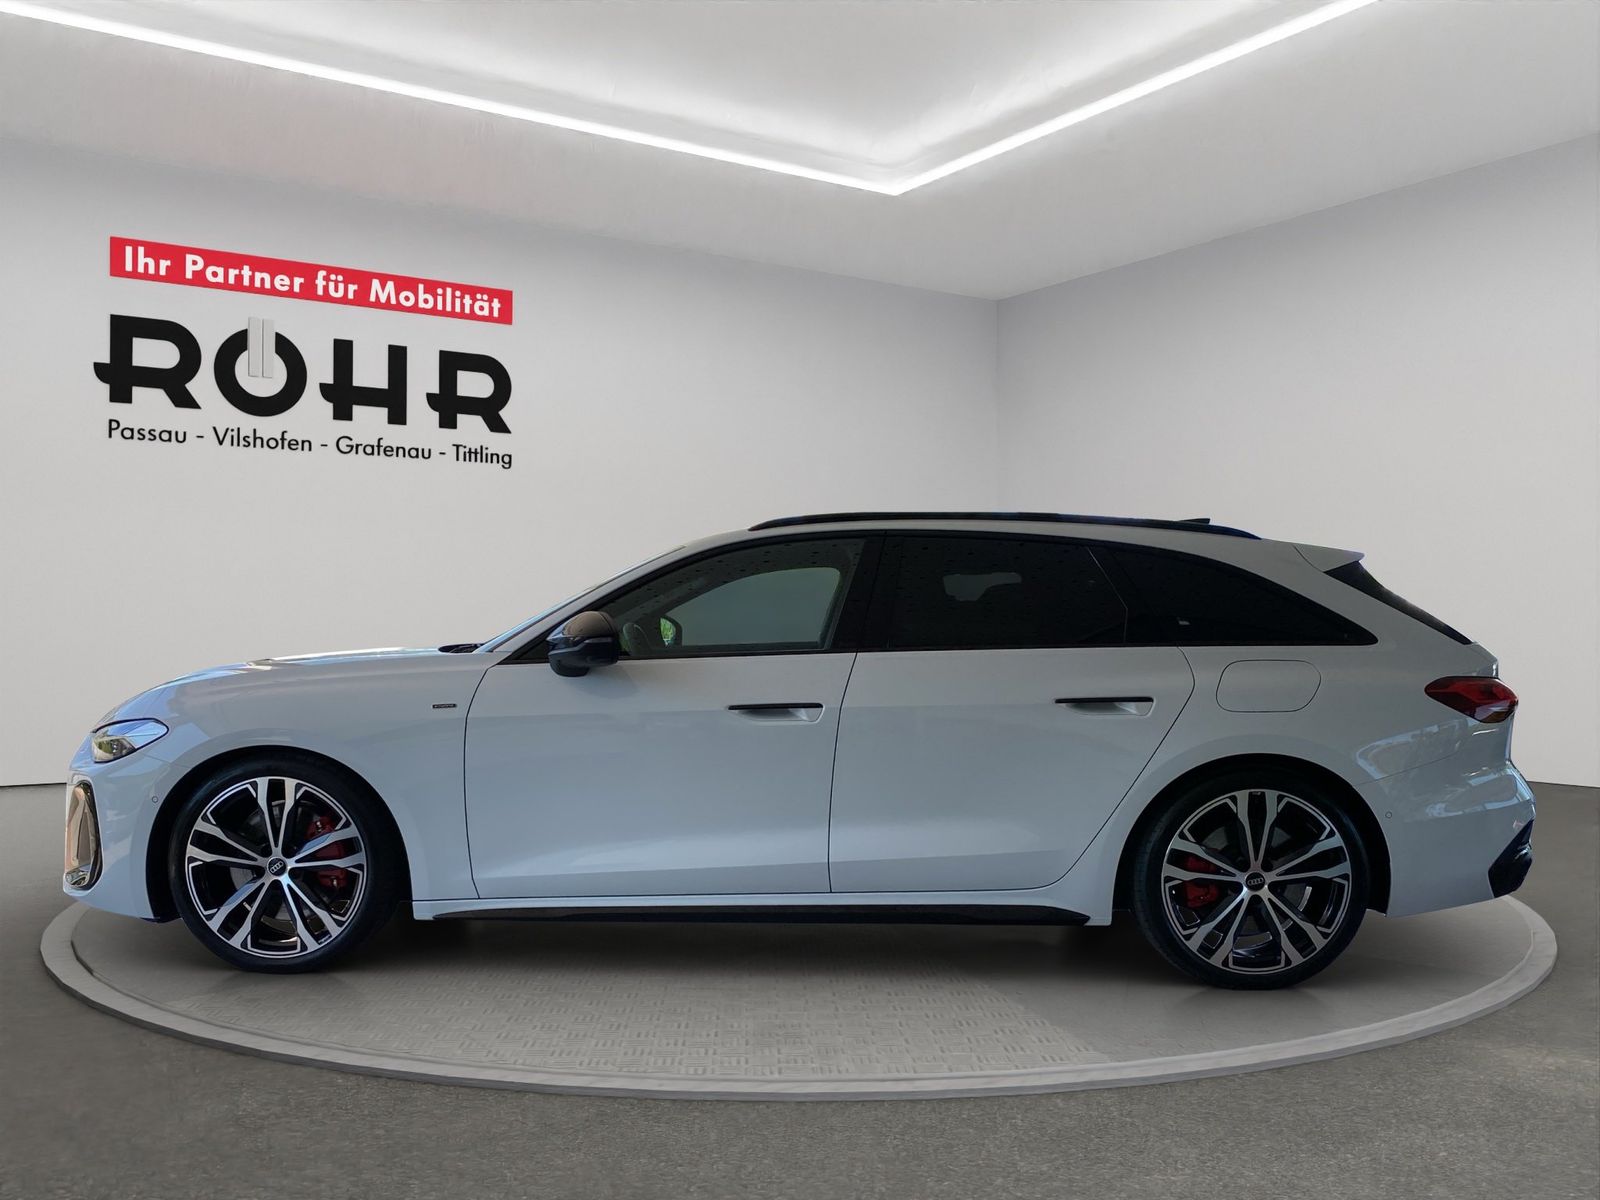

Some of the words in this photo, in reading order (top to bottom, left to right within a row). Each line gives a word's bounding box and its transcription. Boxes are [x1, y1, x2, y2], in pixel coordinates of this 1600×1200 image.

[125, 245, 171, 276] Ihr
[185, 253, 305, 293] Partner
[315, 270, 358, 300] für
[369, 278, 501, 318] Mobilität
[108, 418, 187, 444] Passau
[212, 426, 312, 452] Vilshofen
[335, 435, 432, 460] Grafenau
[452, 443, 513, 470] Tittling
